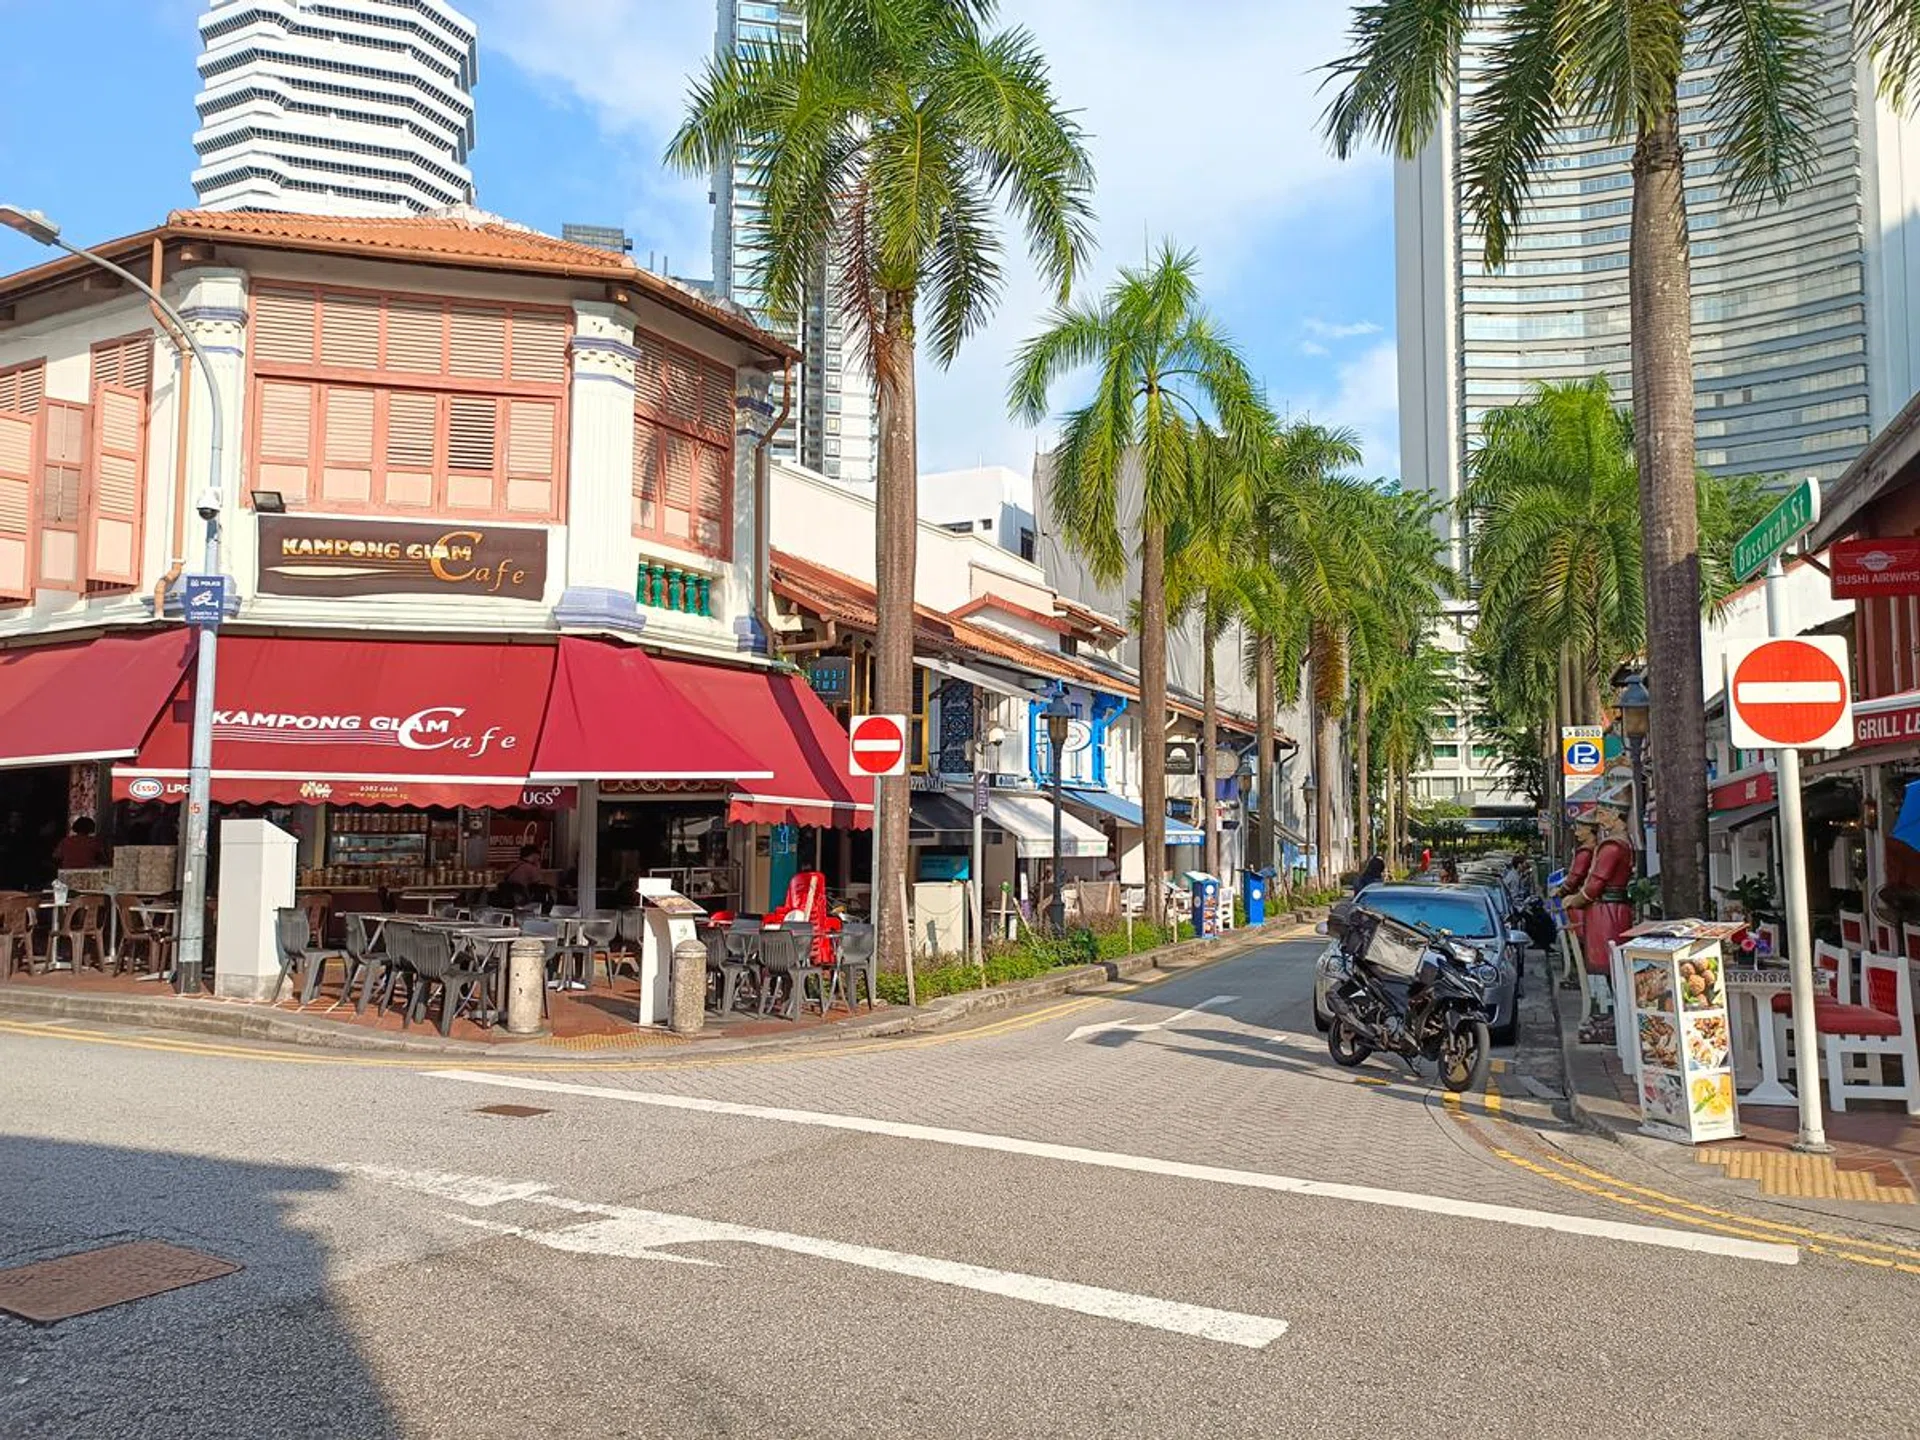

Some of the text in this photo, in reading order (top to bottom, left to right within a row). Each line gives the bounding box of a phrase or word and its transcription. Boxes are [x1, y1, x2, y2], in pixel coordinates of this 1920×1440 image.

[1739, 494, 1805, 573] Bussorah St
[281, 538, 472, 561] KAMPONG GLAM
[430, 531, 525, 592] Cafe
[1835, 571, 1920, 585] SUSHI AIRWAYS
[211, 710, 450, 733] KAMPONG GLAM
[398, 706, 516, 758] Cafe
[1857, 716, 1901, 741] GRILL
[523, 791, 554, 805] UGS
